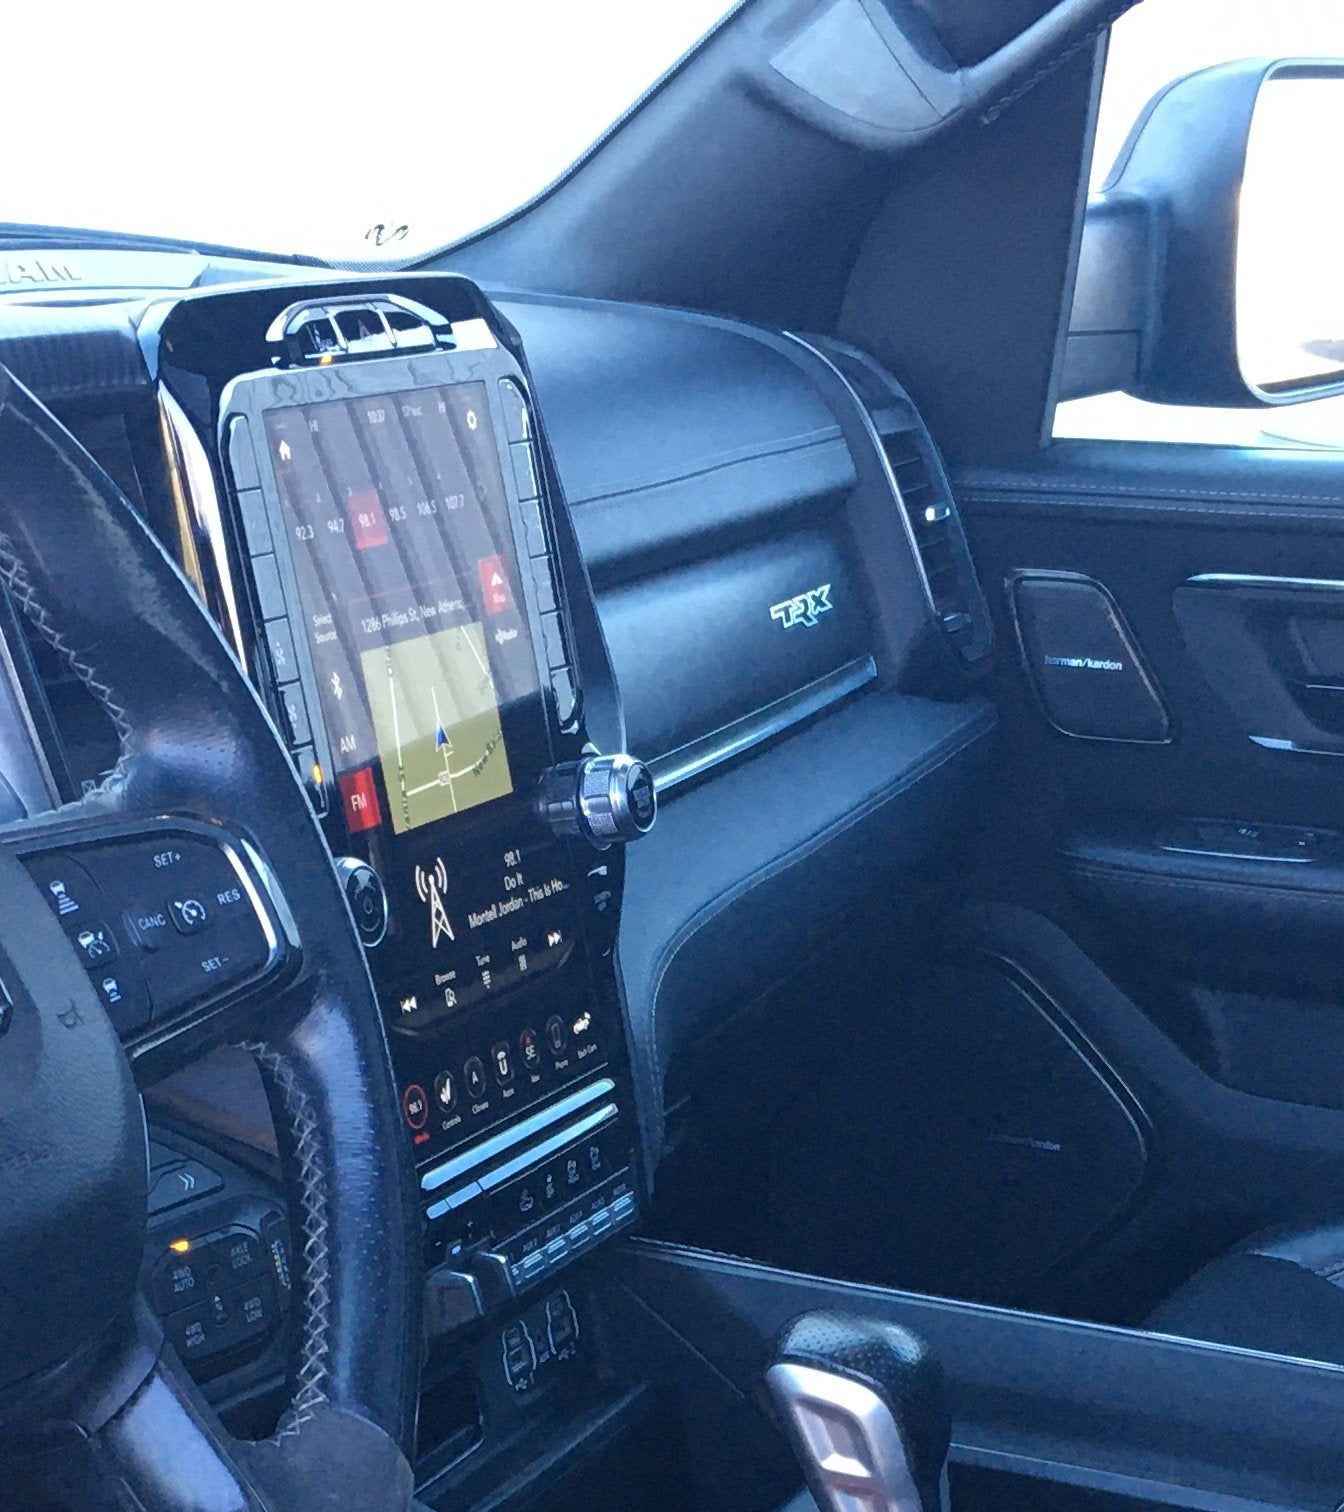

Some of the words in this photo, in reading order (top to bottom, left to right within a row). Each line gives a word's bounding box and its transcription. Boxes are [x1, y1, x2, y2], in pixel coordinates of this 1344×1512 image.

[295, 525, 315, 541] 92.3
[769, 583, 834, 629] TRX
[1044, 655, 1123, 671] harman/kardon
[340, 734, 357, 754] AM
[350, 792, 368, 812] FM
[217, 887, 241, 906] RES
[467, 903, 497, 929] Montell
[498, 896, 525, 918] Jordan
[527, 886, 545, 903] This
[137, 913, 167, 931] CANC
